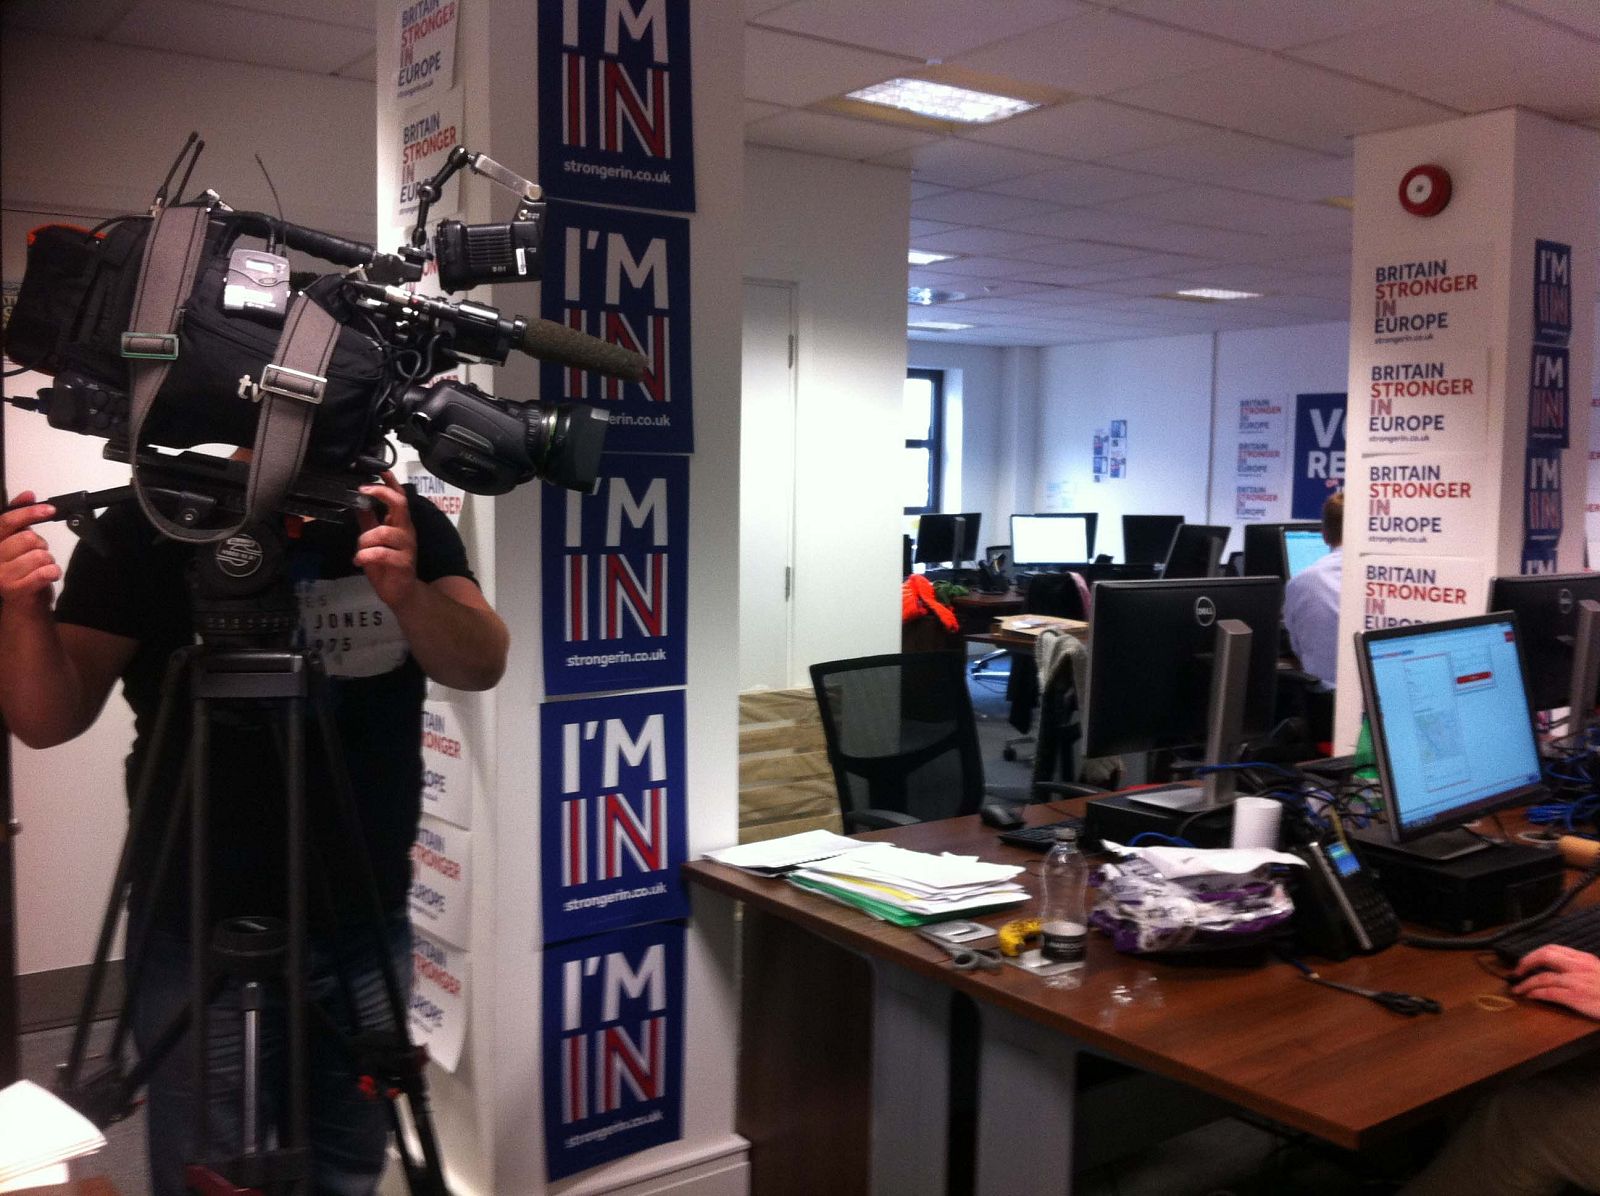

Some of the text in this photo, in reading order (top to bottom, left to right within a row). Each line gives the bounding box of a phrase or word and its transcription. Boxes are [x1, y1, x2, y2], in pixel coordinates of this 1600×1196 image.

[401, 2, 456, 48] STRONGER
[398, 51, 441, 87] EUROPE
[563, 53, 671, 160] IN
[403, 112, 440, 145] BRITAIN
[402, 126, 457, 165] STRONGER
[402, 162, 415, 185] IN
[564, 159, 672, 184] strongerin.co.uk
[564, 227, 669, 310] I'M
[1375, 260, 1448, 283] BRITAIN
[1540, 250, 1568, 286] I'M
[1375, 274, 1479, 300] STRONGER
[1375, 300, 1397, 318] IN
[1374, 312, 1449, 334] EUROPE
[564, 308, 671, 402] IN
[1371, 362, 1445, 381] BRITAIN
[1533, 354, 1564, 389] I'M
[1370, 378, 1474, 399] STRONGER
[1370, 399, 1392, 416] IN
[608, 413, 672, 428] erin.co.uk
[1369, 415, 1445, 432] EUROPE
[1369, 465, 1441, 481] BRITAIN
[1369, 482, 1471, 499] STRONGER
[1369, 499, 1391, 516] IN
[1368, 517, 1442, 533] EUROPE
[1368, 535, 1428, 544] strongerin.co.uk
[1366, 565, 1437, 584] BRITAIN
[564, 553, 668, 642] IN
[1365, 582, 1468, 604] STRONGER
[1365, 599, 1386, 615] IN
[313, 610, 383, 629] JONES
[565, 648, 667, 667] strongerin.co.uk
[562, 713, 667, 794] I'M
[561, 787, 668, 887] IN
[563, 881, 668, 911] strongerin.co.uk
[561, 944, 667, 1031] I'M
[560, 1016, 667, 1124] IN
